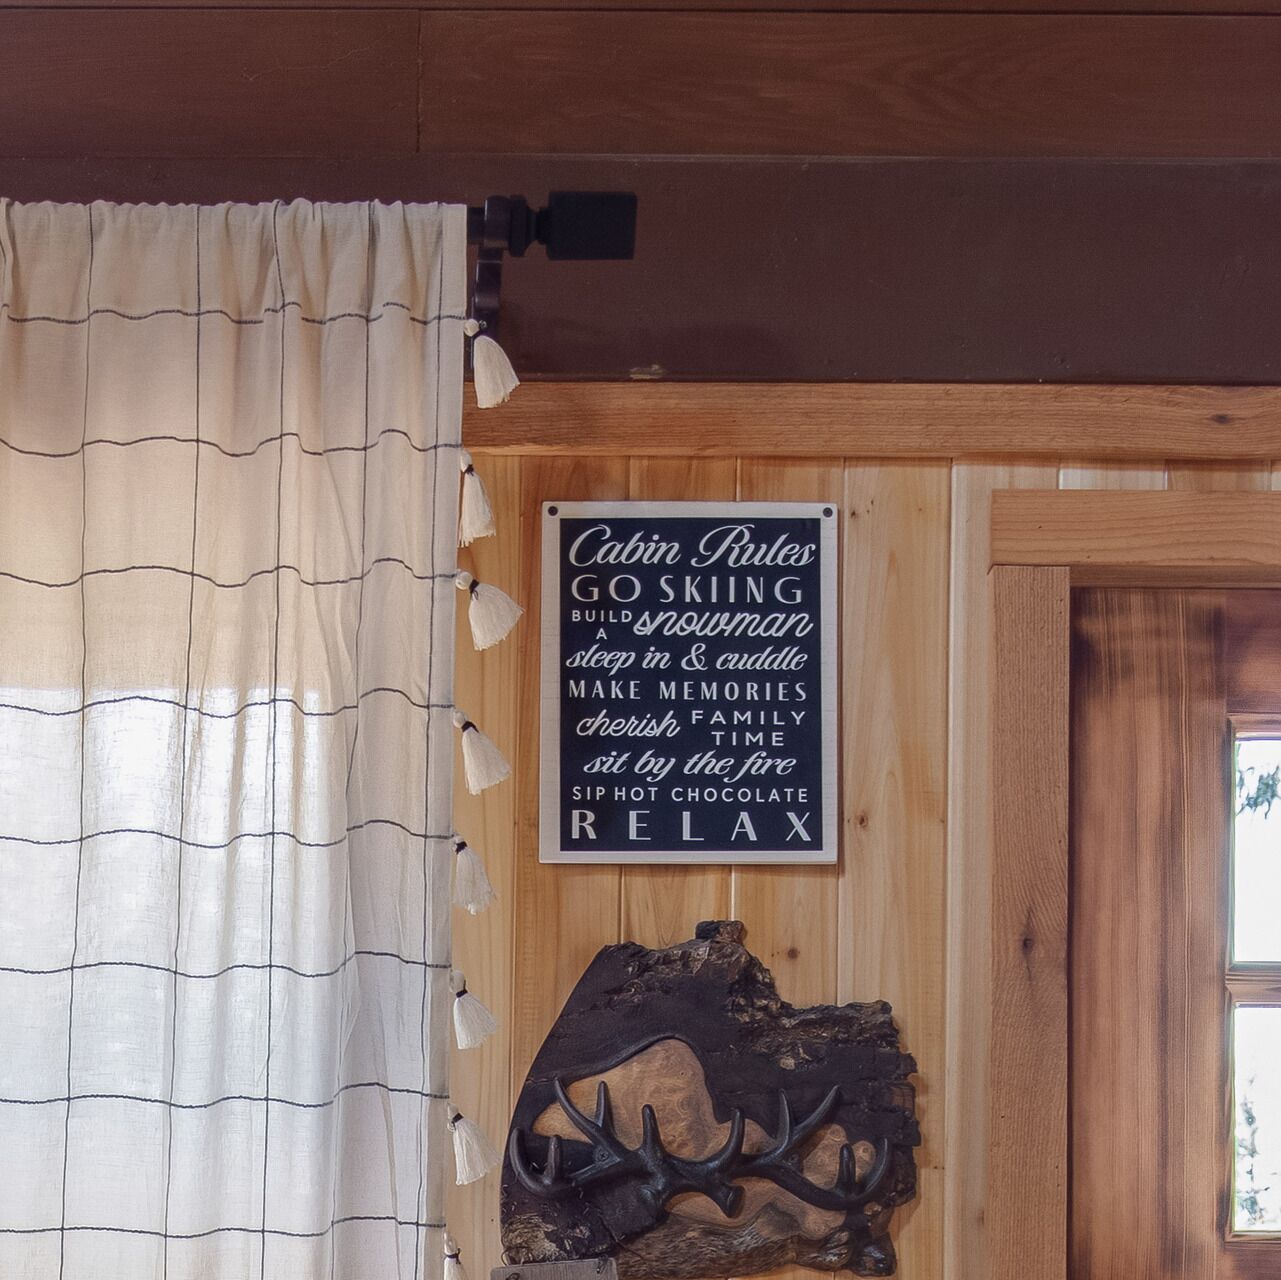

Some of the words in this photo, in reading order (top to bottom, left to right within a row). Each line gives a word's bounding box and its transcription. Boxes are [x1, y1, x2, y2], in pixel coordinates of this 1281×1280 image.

[569, 525, 681, 567] Cabin
[691, 524, 815, 567] Rules
[571, 575, 641, 602] GO
[660, 575, 803, 604] SKIING
[572, 610, 632, 623] BUILD
[633, 611, 813, 637] snowman
[596, 628, 607, 640] A
[566, 645, 635, 675] sleep
[641, 647, 671, 669] in
[681, 643, 707, 671] &
[715, 646, 807, 671] cuddle
[569, 681, 641, 699] MAKE
[660, 681, 807, 701] MEMORIES
[576, 709, 680, 737] cherish
[692, 711, 806, 725] FAMILY
[711, 732, 784, 746] TIME
[584, 751, 628, 774] sit
[634, 750, 676, 782] by
[683, 751, 734, 775] the
[724, 752, 796, 782] fire
[572, 787, 605, 801] SIP
[615, 787, 658, 801] HOT
[672, 788, 808, 803] CHOCOLATE
[571, 810, 812, 842] RELAX
